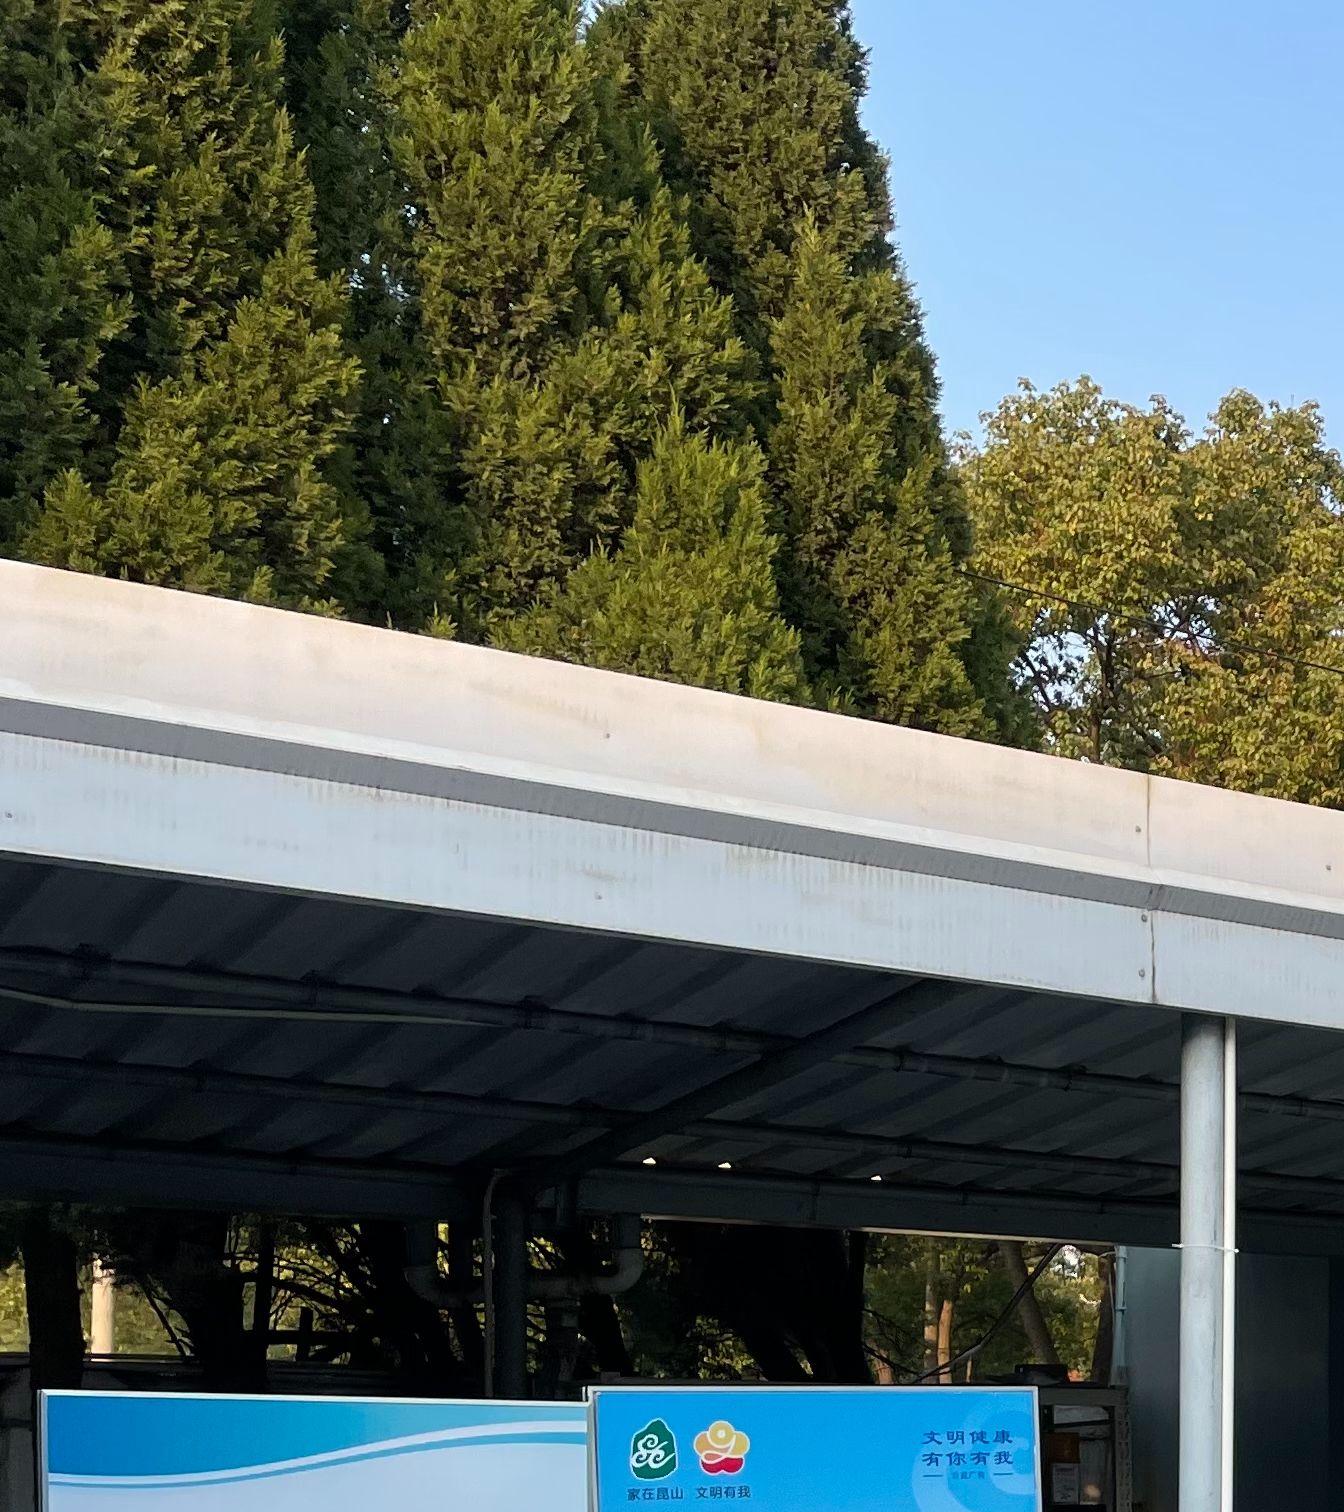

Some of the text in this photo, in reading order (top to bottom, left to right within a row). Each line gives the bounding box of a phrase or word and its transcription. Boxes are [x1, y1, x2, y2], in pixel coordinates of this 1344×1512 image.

[921, 1429, 1014, 1446] 文明健康
[922, 1451, 1014, 1467] 有你有我
[627, 1485, 752, 1501] 家在昆山 文明有我
